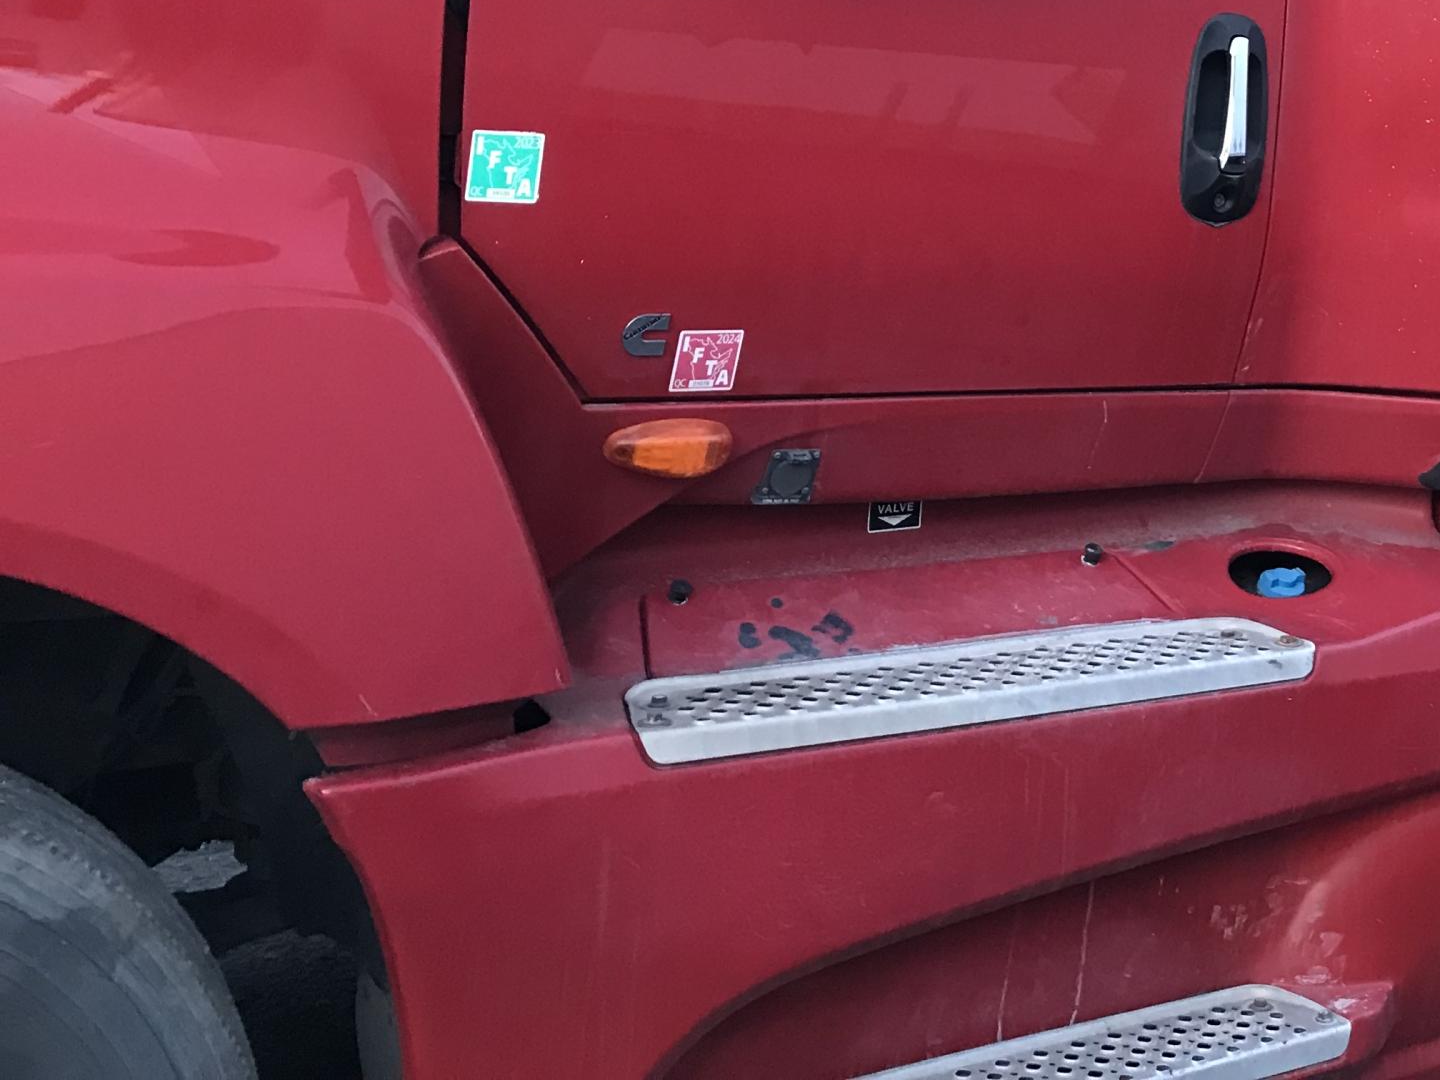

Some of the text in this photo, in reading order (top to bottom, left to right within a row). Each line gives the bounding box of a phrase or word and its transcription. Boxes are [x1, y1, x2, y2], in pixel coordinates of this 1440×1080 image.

[470, 185, 484, 196] QC
[716, 334, 741, 345] 2024
[674, 378, 687, 389] QC
[877, 502, 914, 514] VALVE
